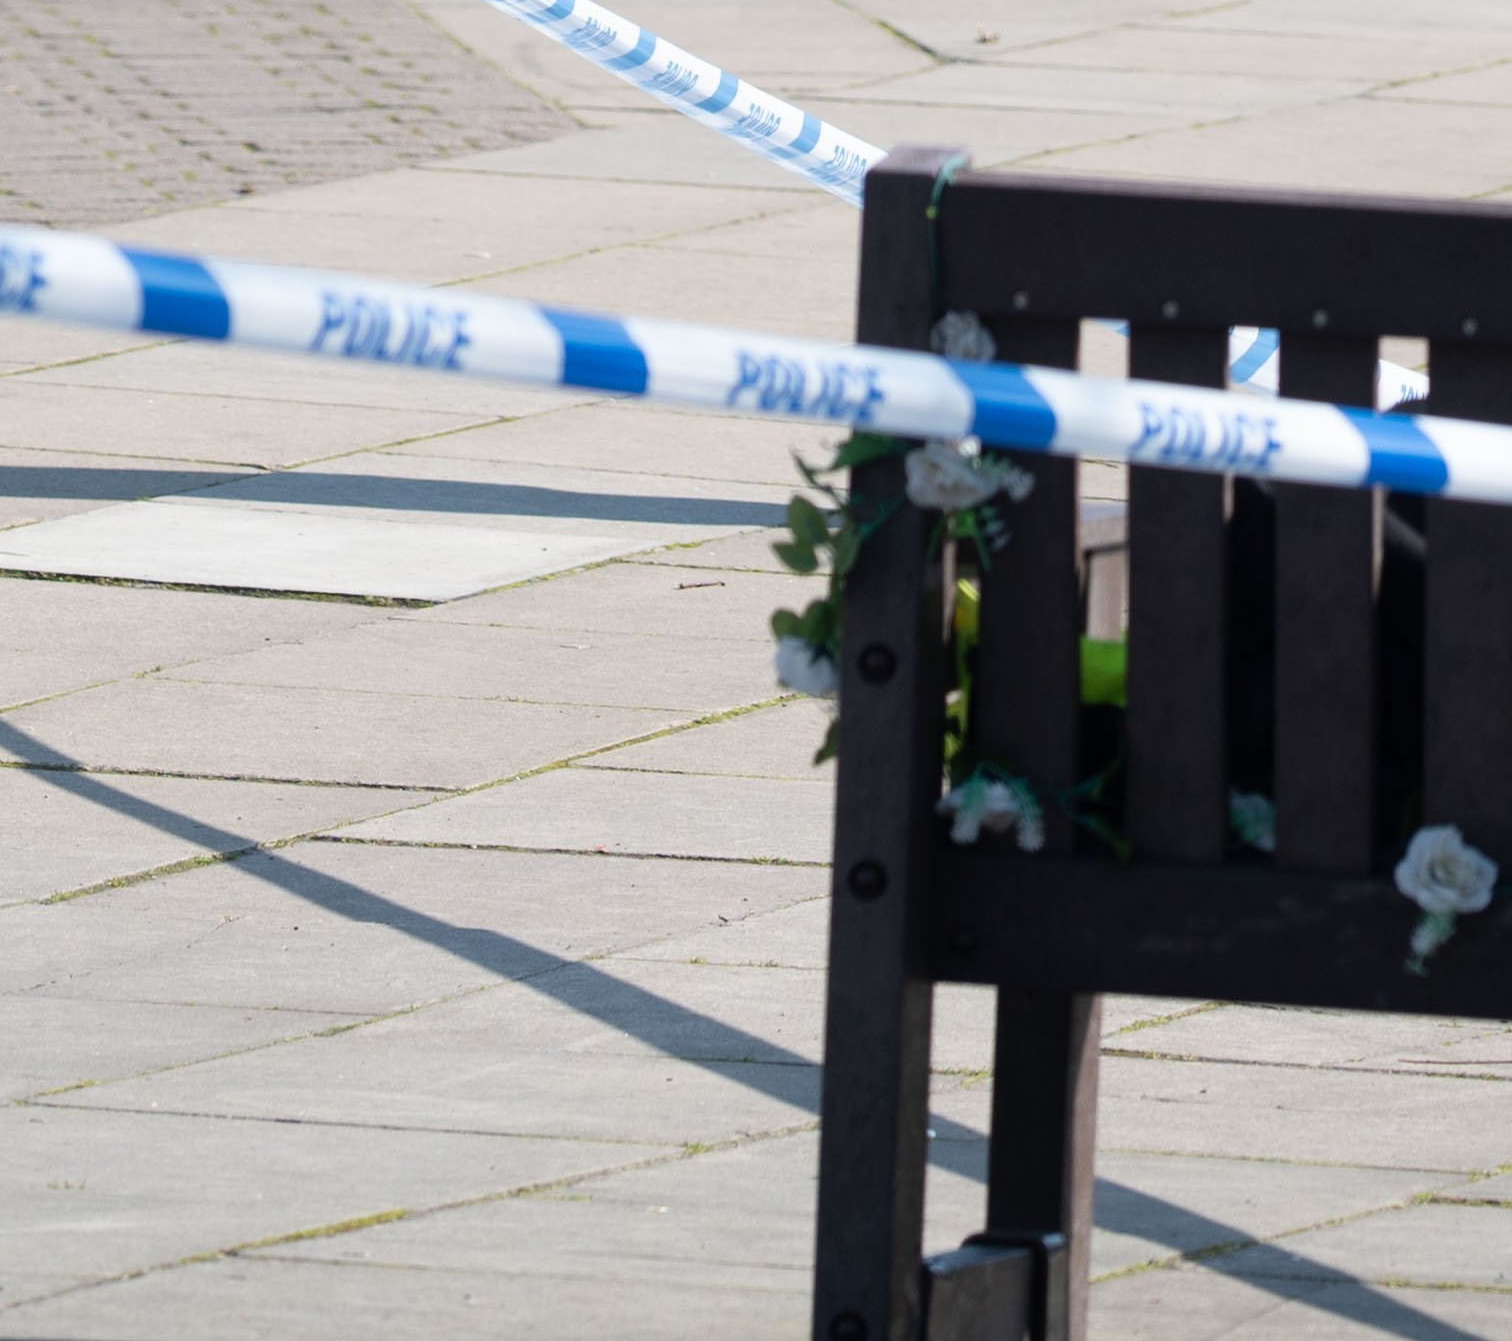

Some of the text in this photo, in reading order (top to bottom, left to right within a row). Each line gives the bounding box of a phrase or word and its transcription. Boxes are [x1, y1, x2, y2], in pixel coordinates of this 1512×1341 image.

[311, 291, 472, 368] POLICE
[729, 352, 885, 423] POLICE
[1133, 403, 1282, 472] POLICE
